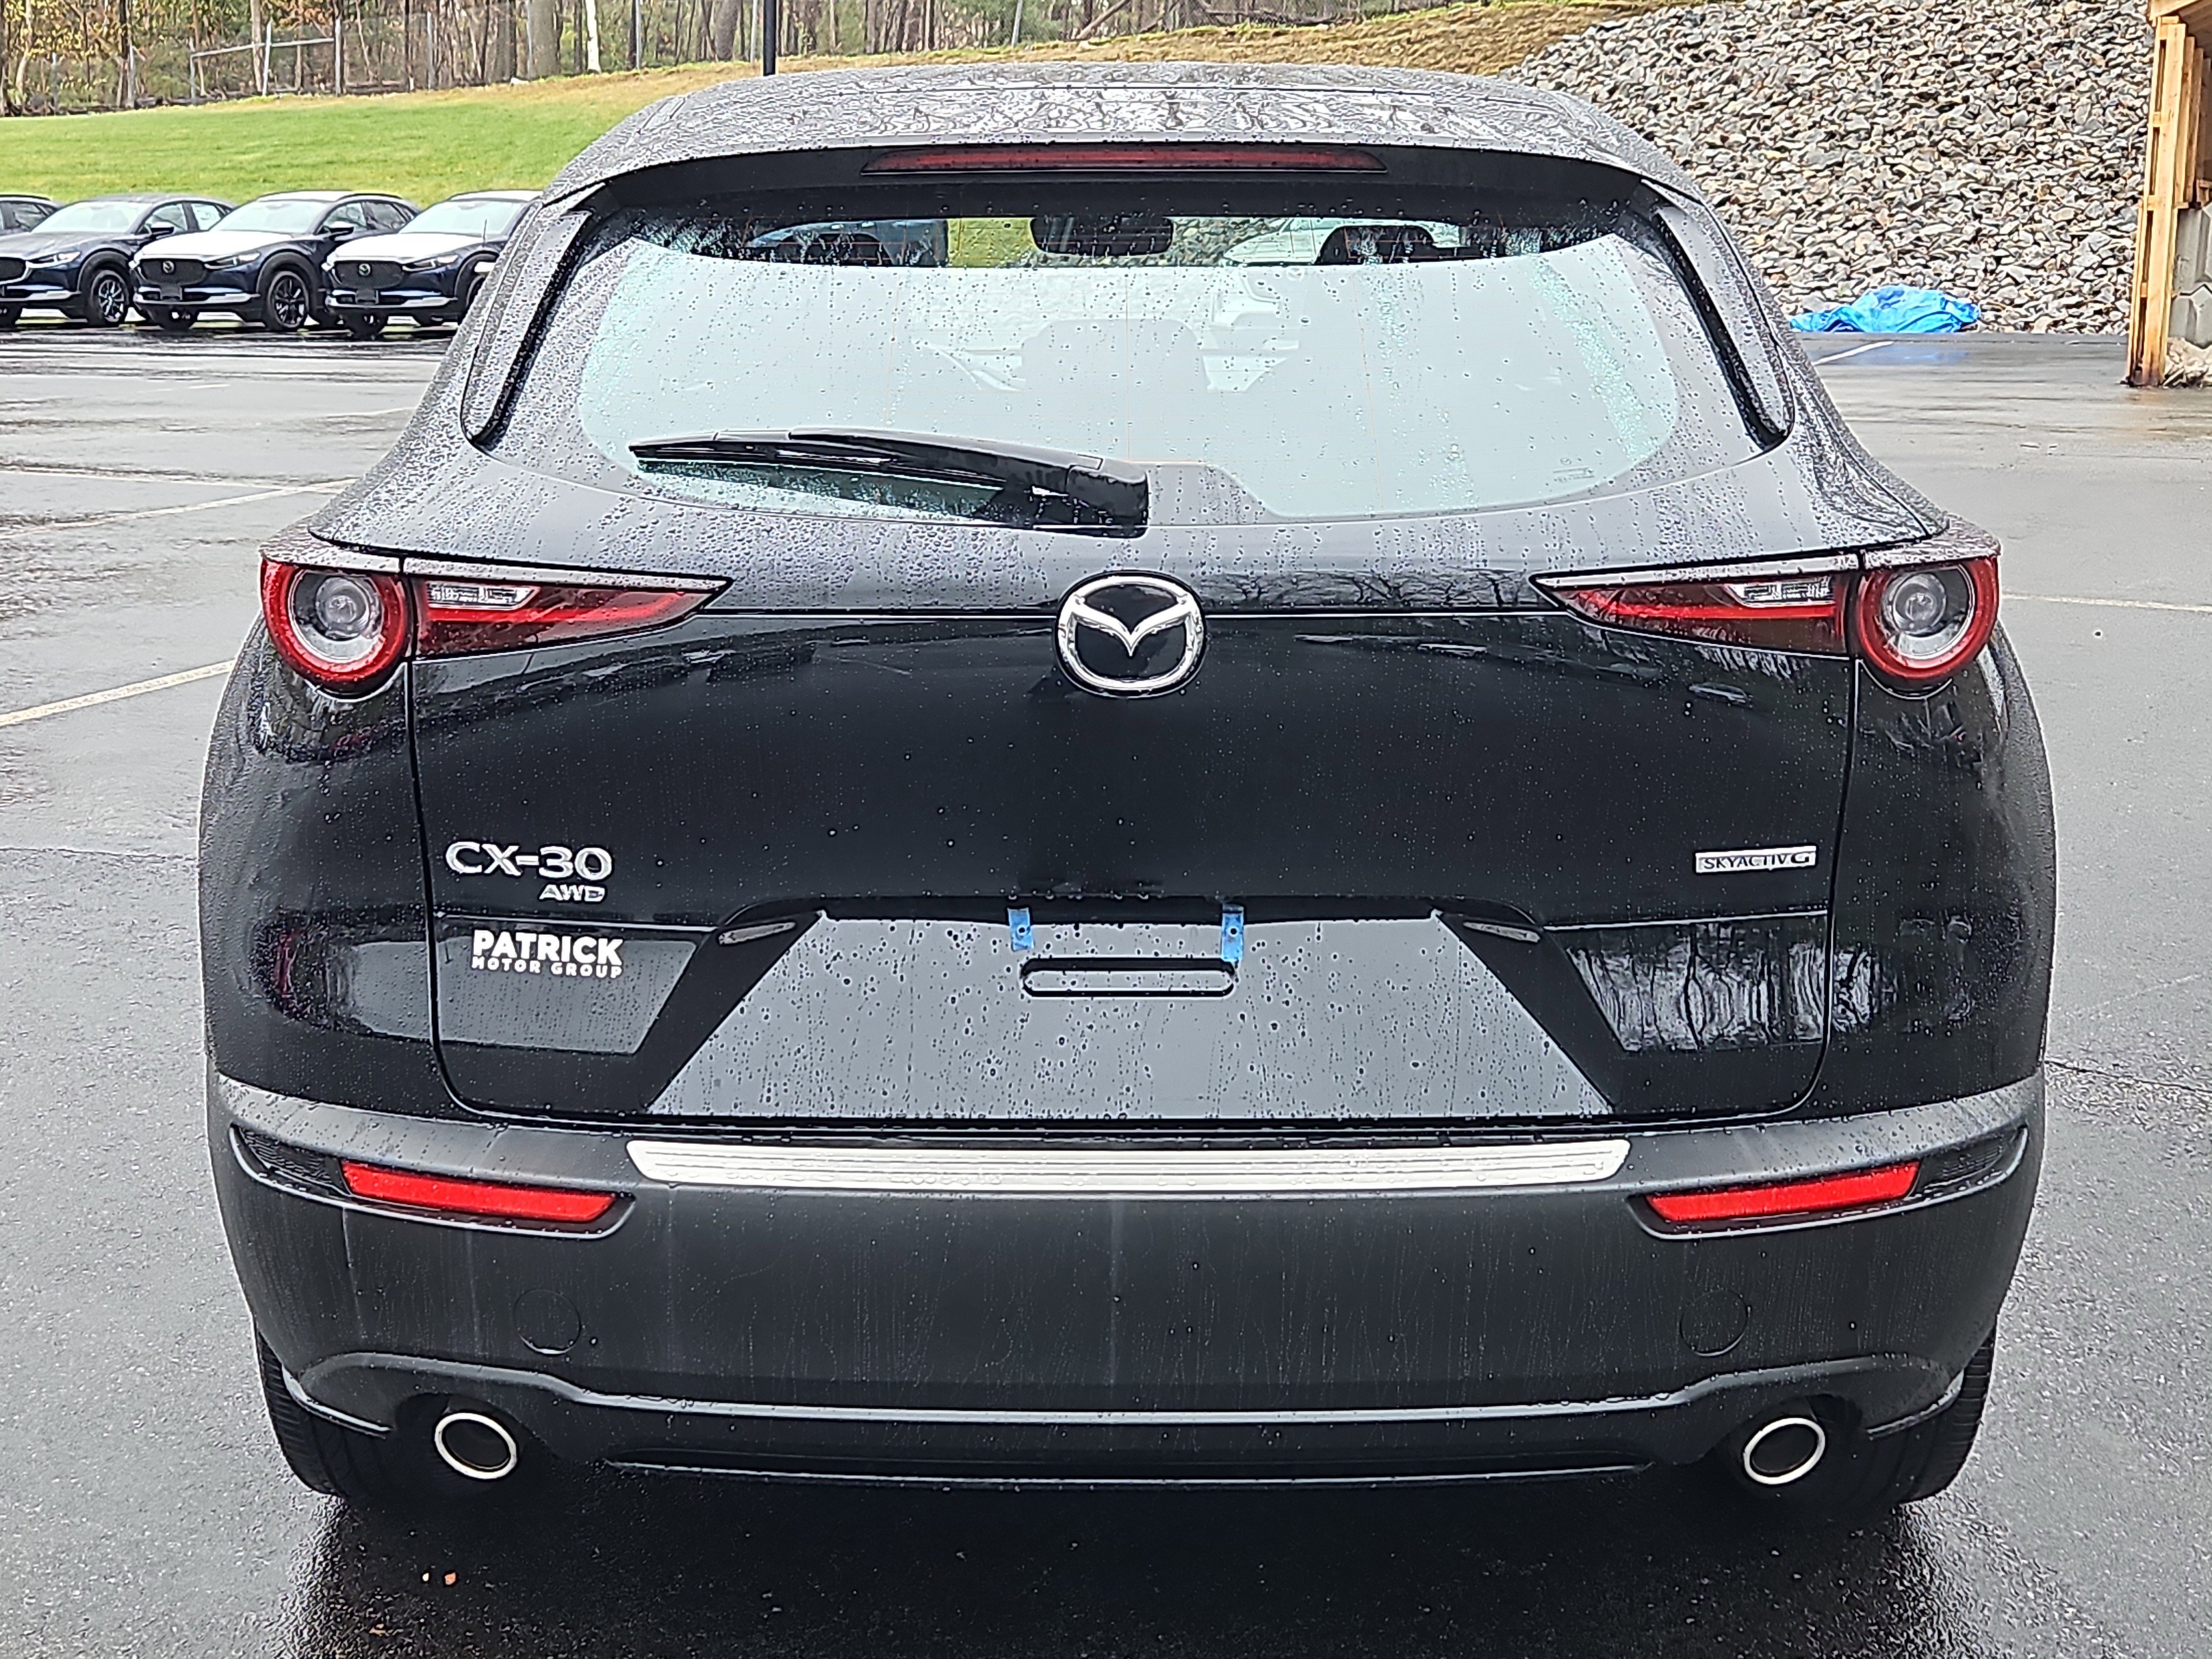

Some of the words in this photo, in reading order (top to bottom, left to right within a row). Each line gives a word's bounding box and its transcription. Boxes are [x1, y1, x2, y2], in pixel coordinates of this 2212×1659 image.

[445, 841, 612, 880] CX-30
[538, 884, 605, 902] AWD
[472, 929, 623, 966] PATRICK
[471, 956, 541, 974] MOTOR
[550, 962, 622, 979] GROUP
